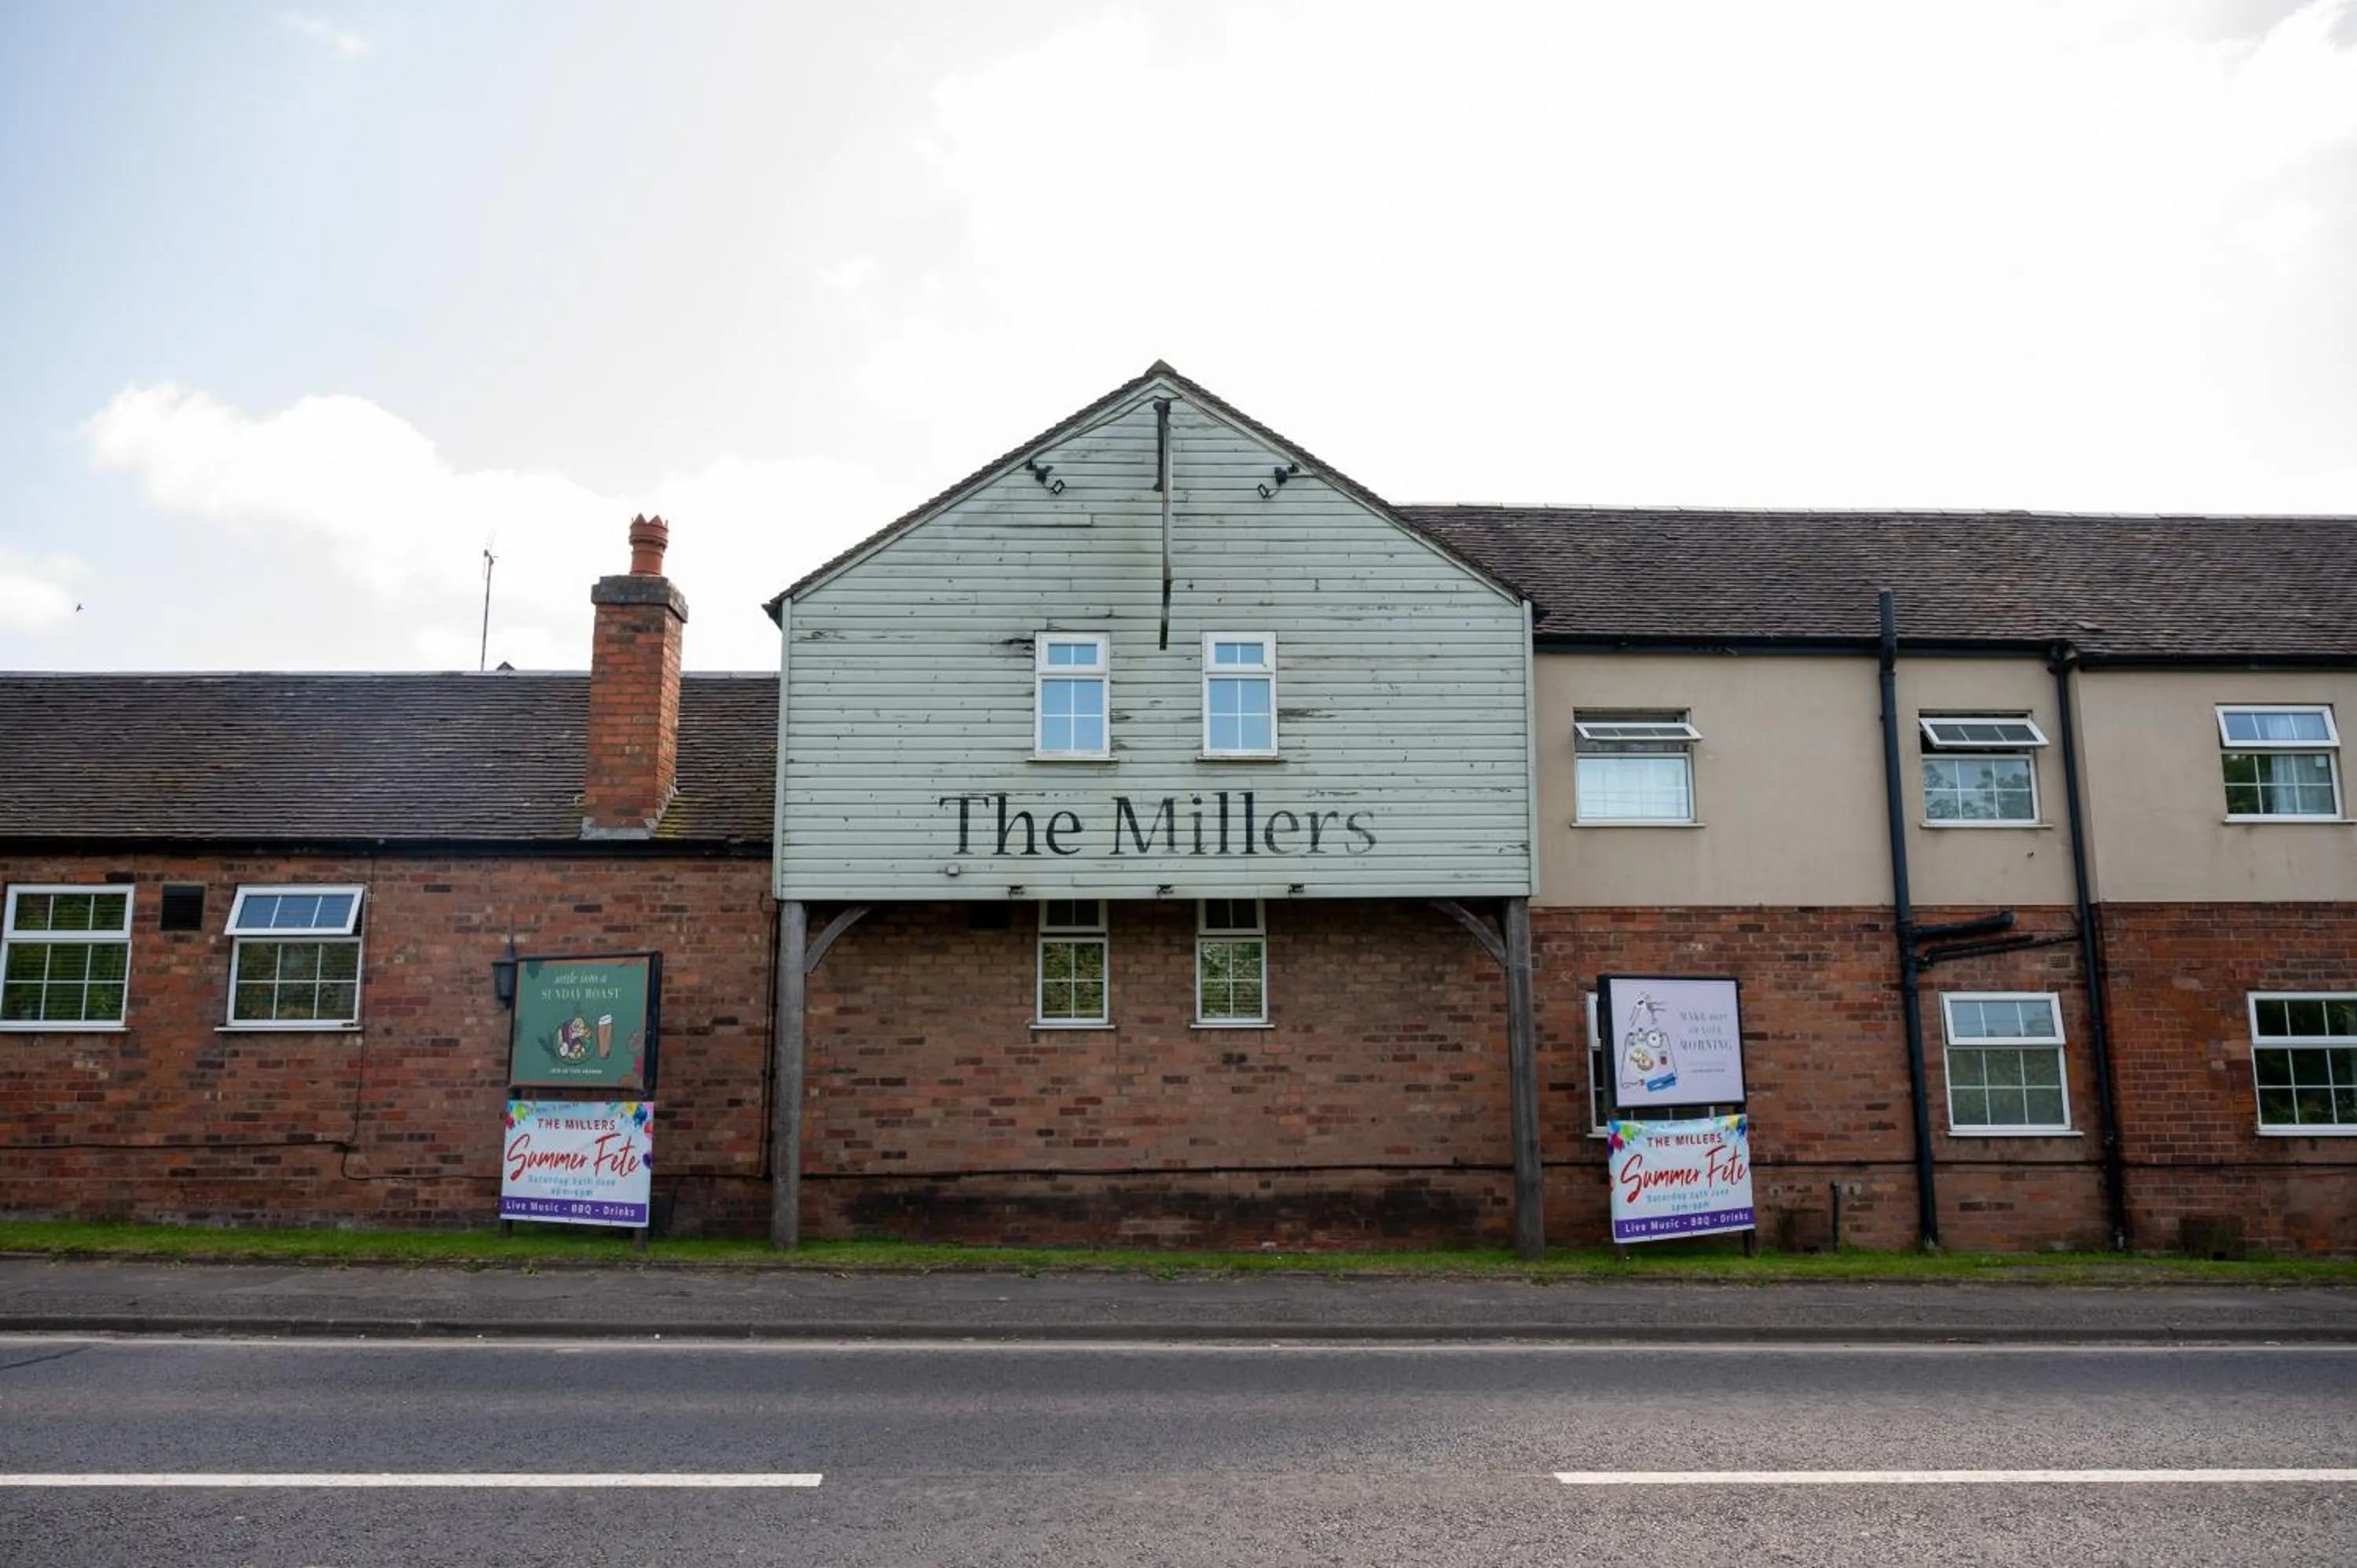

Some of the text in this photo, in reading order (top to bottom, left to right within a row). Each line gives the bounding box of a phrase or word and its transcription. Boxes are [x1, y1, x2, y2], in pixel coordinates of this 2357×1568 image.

[939, 792, 1376, 855] The Millers
[541, 987, 621, 1000] SUNDAY ROAST
[1680, 1039, 1733, 1051] MORNING
[537, 1118, 615, 1130] THE MILLERS
[1646, 1133, 1722, 1148] THE MILLERS
[507, 1133, 640, 1181] Summer Fete
[527, 1174, 568, 1186] Saturday
[1620, 1145, 1747, 1203] Summer Fete
[1646, 1192, 1686, 1203] Saturday
[505, 1200, 526, 1211] Live
[530, 1202, 559, 1212] Music
[571, 1203, 591, 1215] BBQ
[603, 1206, 636, 1217] Drinks
[1626, 1223, 1646, 1233] Live
[1651, 1219, 1679, 1230] Music
[1691, 1216, 1710, 1226] BBQ
[1720, 1212, 1748, 1222] Drinks
